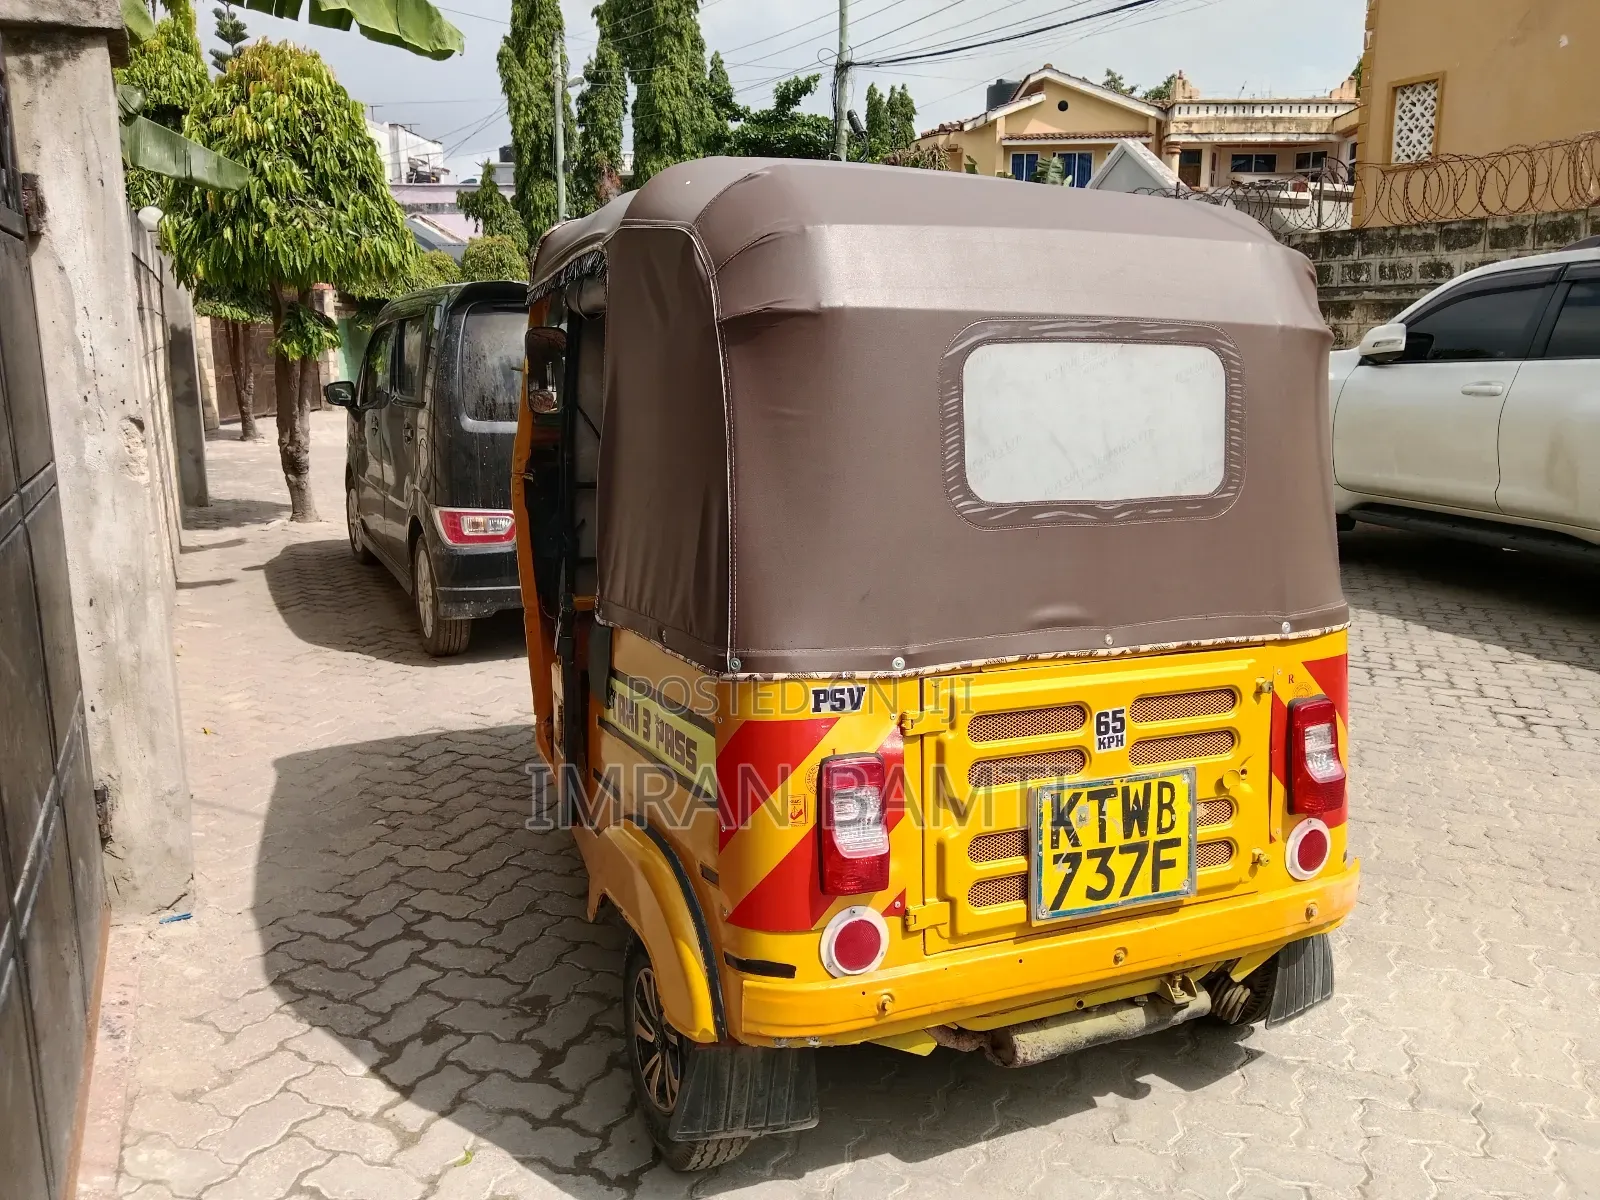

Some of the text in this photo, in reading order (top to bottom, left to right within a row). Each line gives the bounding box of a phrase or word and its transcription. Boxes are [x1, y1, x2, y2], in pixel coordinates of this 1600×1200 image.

[812, 686, 866, 713] PSV
[1095, 708, 1126, 737] 65
[642, 707, 652, 742] 3
[655, 716, 698, 776] PASS
[1097, 734, 1125, 751] KPH
[1050, 780, 1177, 850] KTWB
[1049, 837, 1182, 912] 737F
